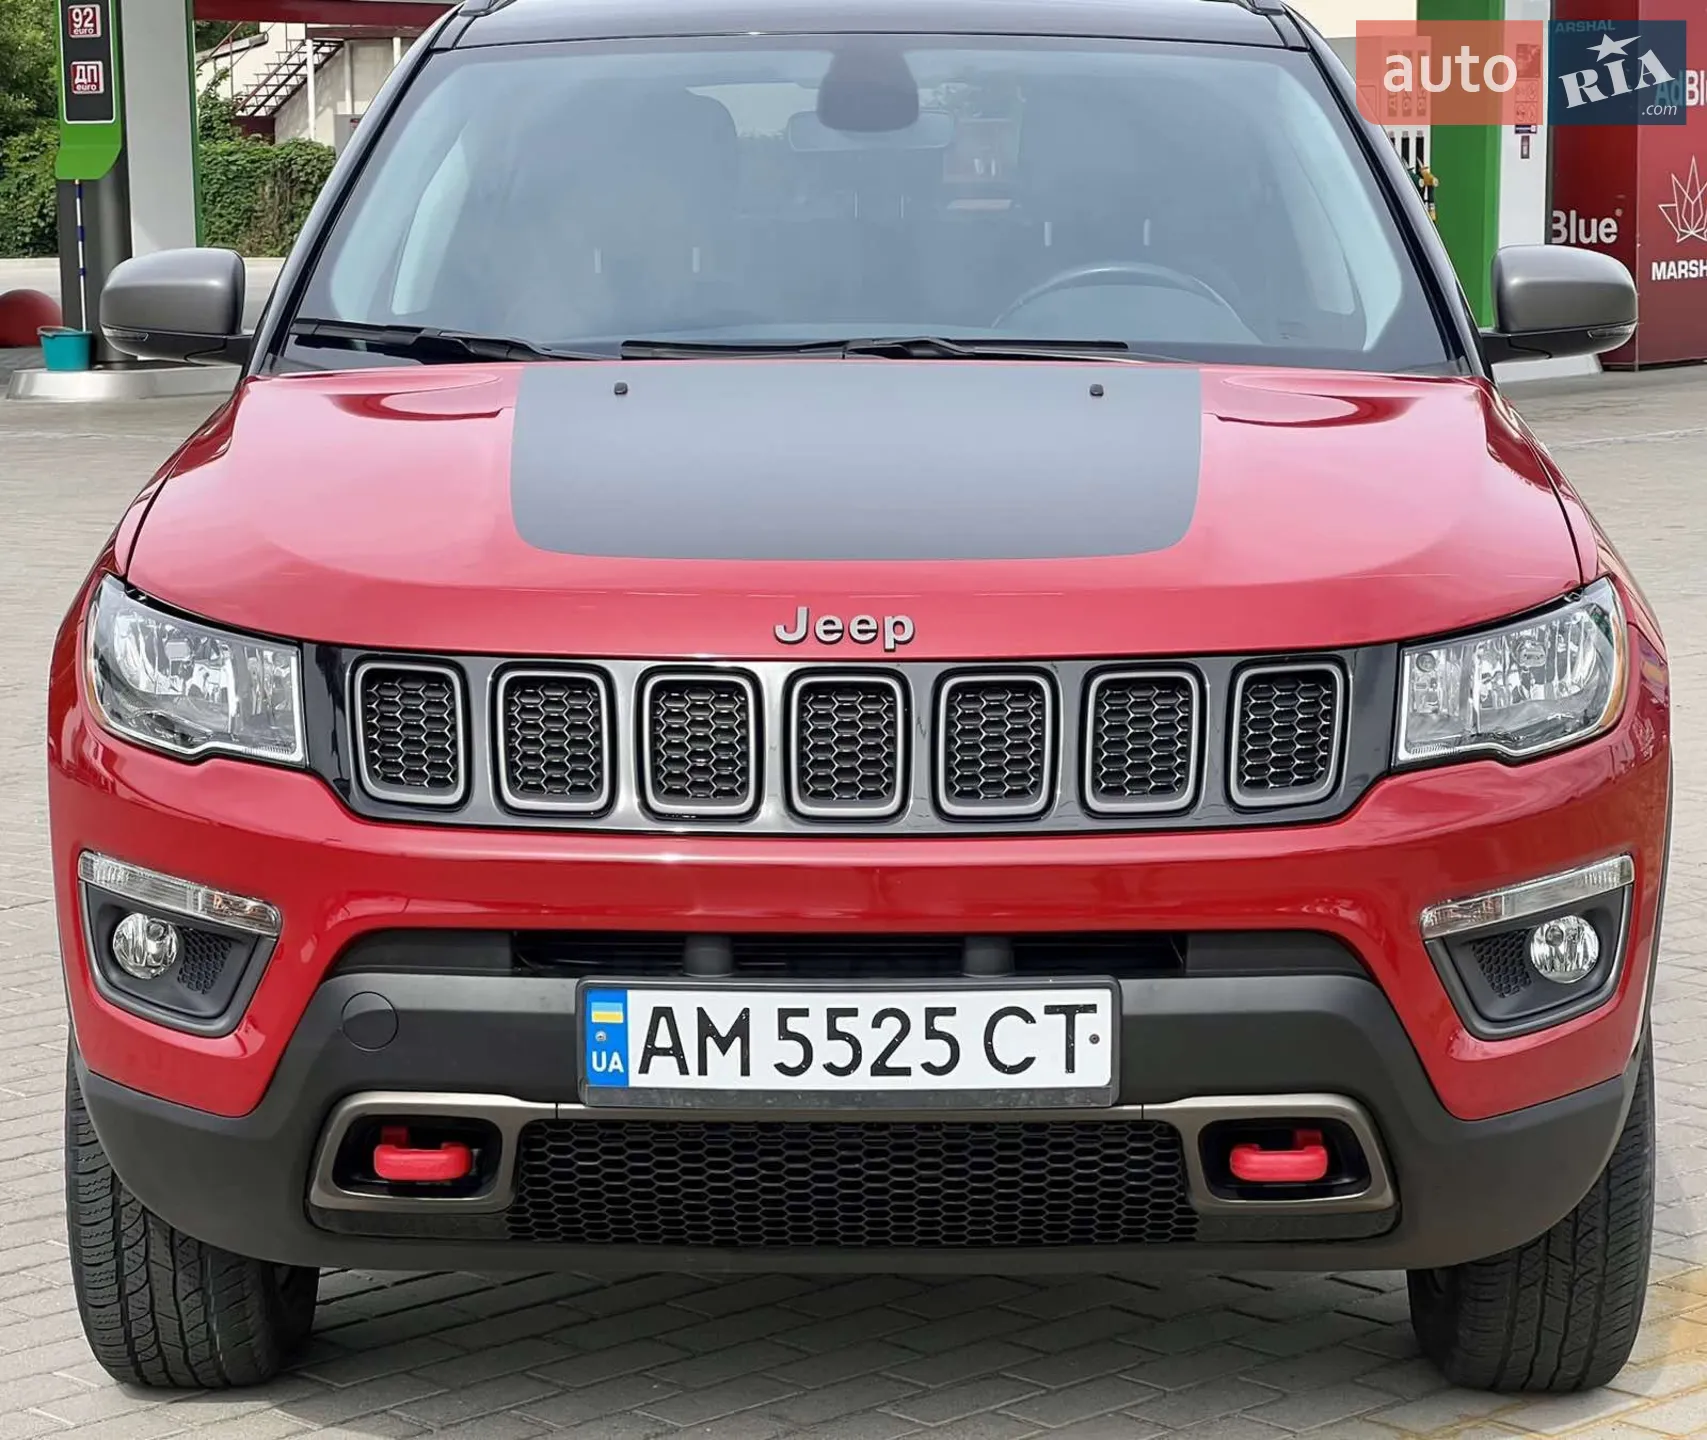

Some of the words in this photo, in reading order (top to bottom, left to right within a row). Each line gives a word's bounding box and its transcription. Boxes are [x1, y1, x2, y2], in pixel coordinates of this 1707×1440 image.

[72, 8, 94, 28] 92
[75, 65, 97, 84] ДП
[1654, 69, 1707, 106] AdBl
[774, 606, 915, 652] Jeep
[638, 1006, 750, 1077] AM
[773, 1006, 960, 1077] 5525
[983, 1003, 1097, 1075] CT
[591, 1050, 624, 1073] UA
